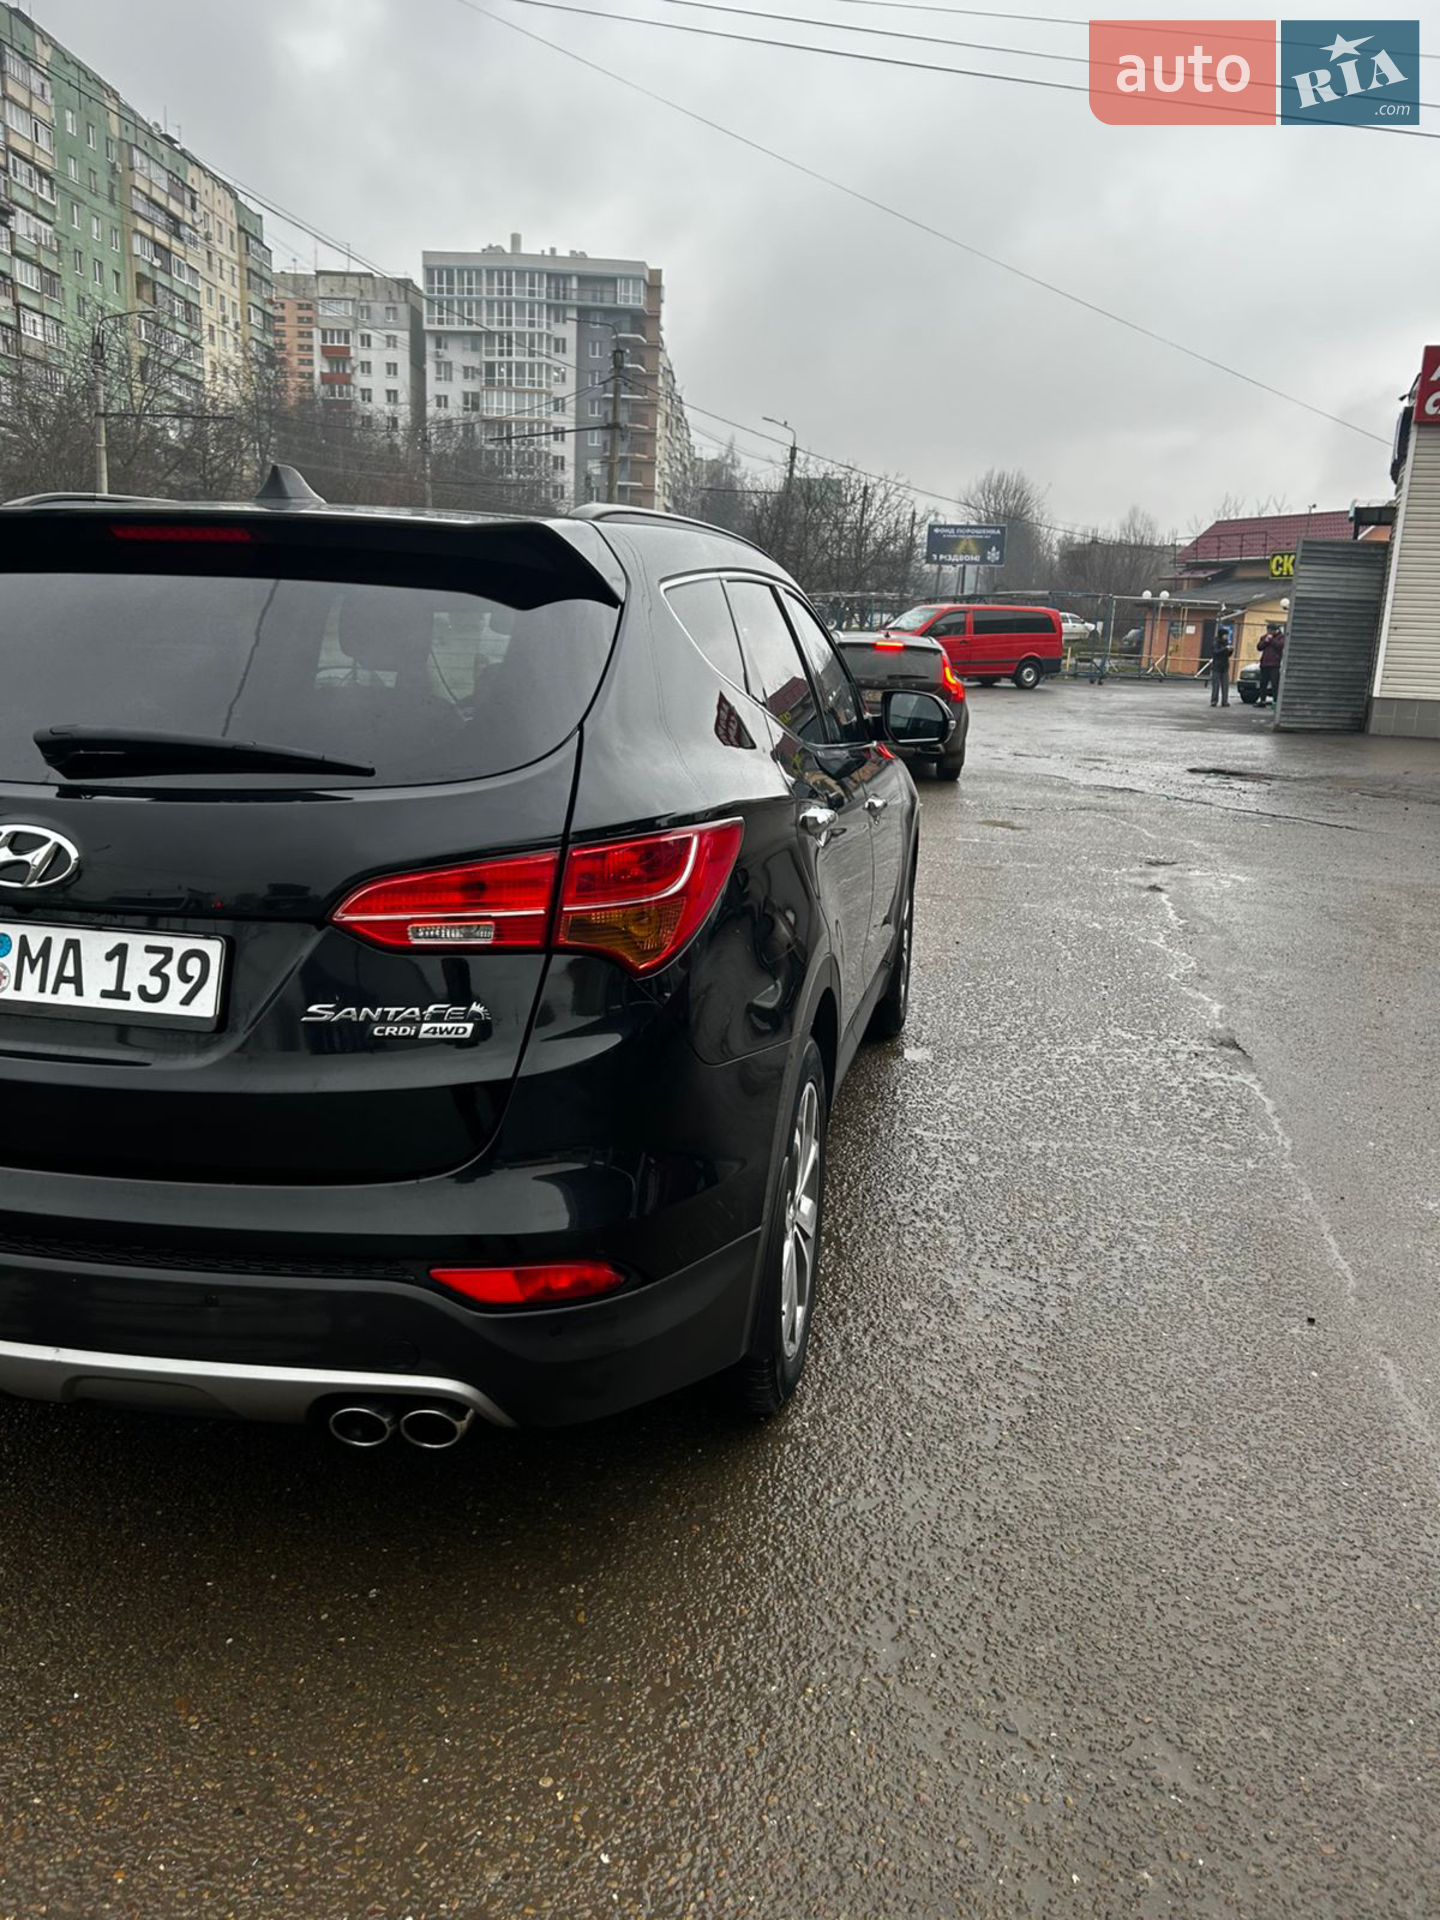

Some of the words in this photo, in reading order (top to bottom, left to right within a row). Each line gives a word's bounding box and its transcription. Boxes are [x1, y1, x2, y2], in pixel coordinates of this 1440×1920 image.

[14, 934, 84, 997] MA
[100, 942, 211, 1006] 139
[373, 1025, 417, 1037] CRDi
[423, 1026, 468, 1036] 4WD
